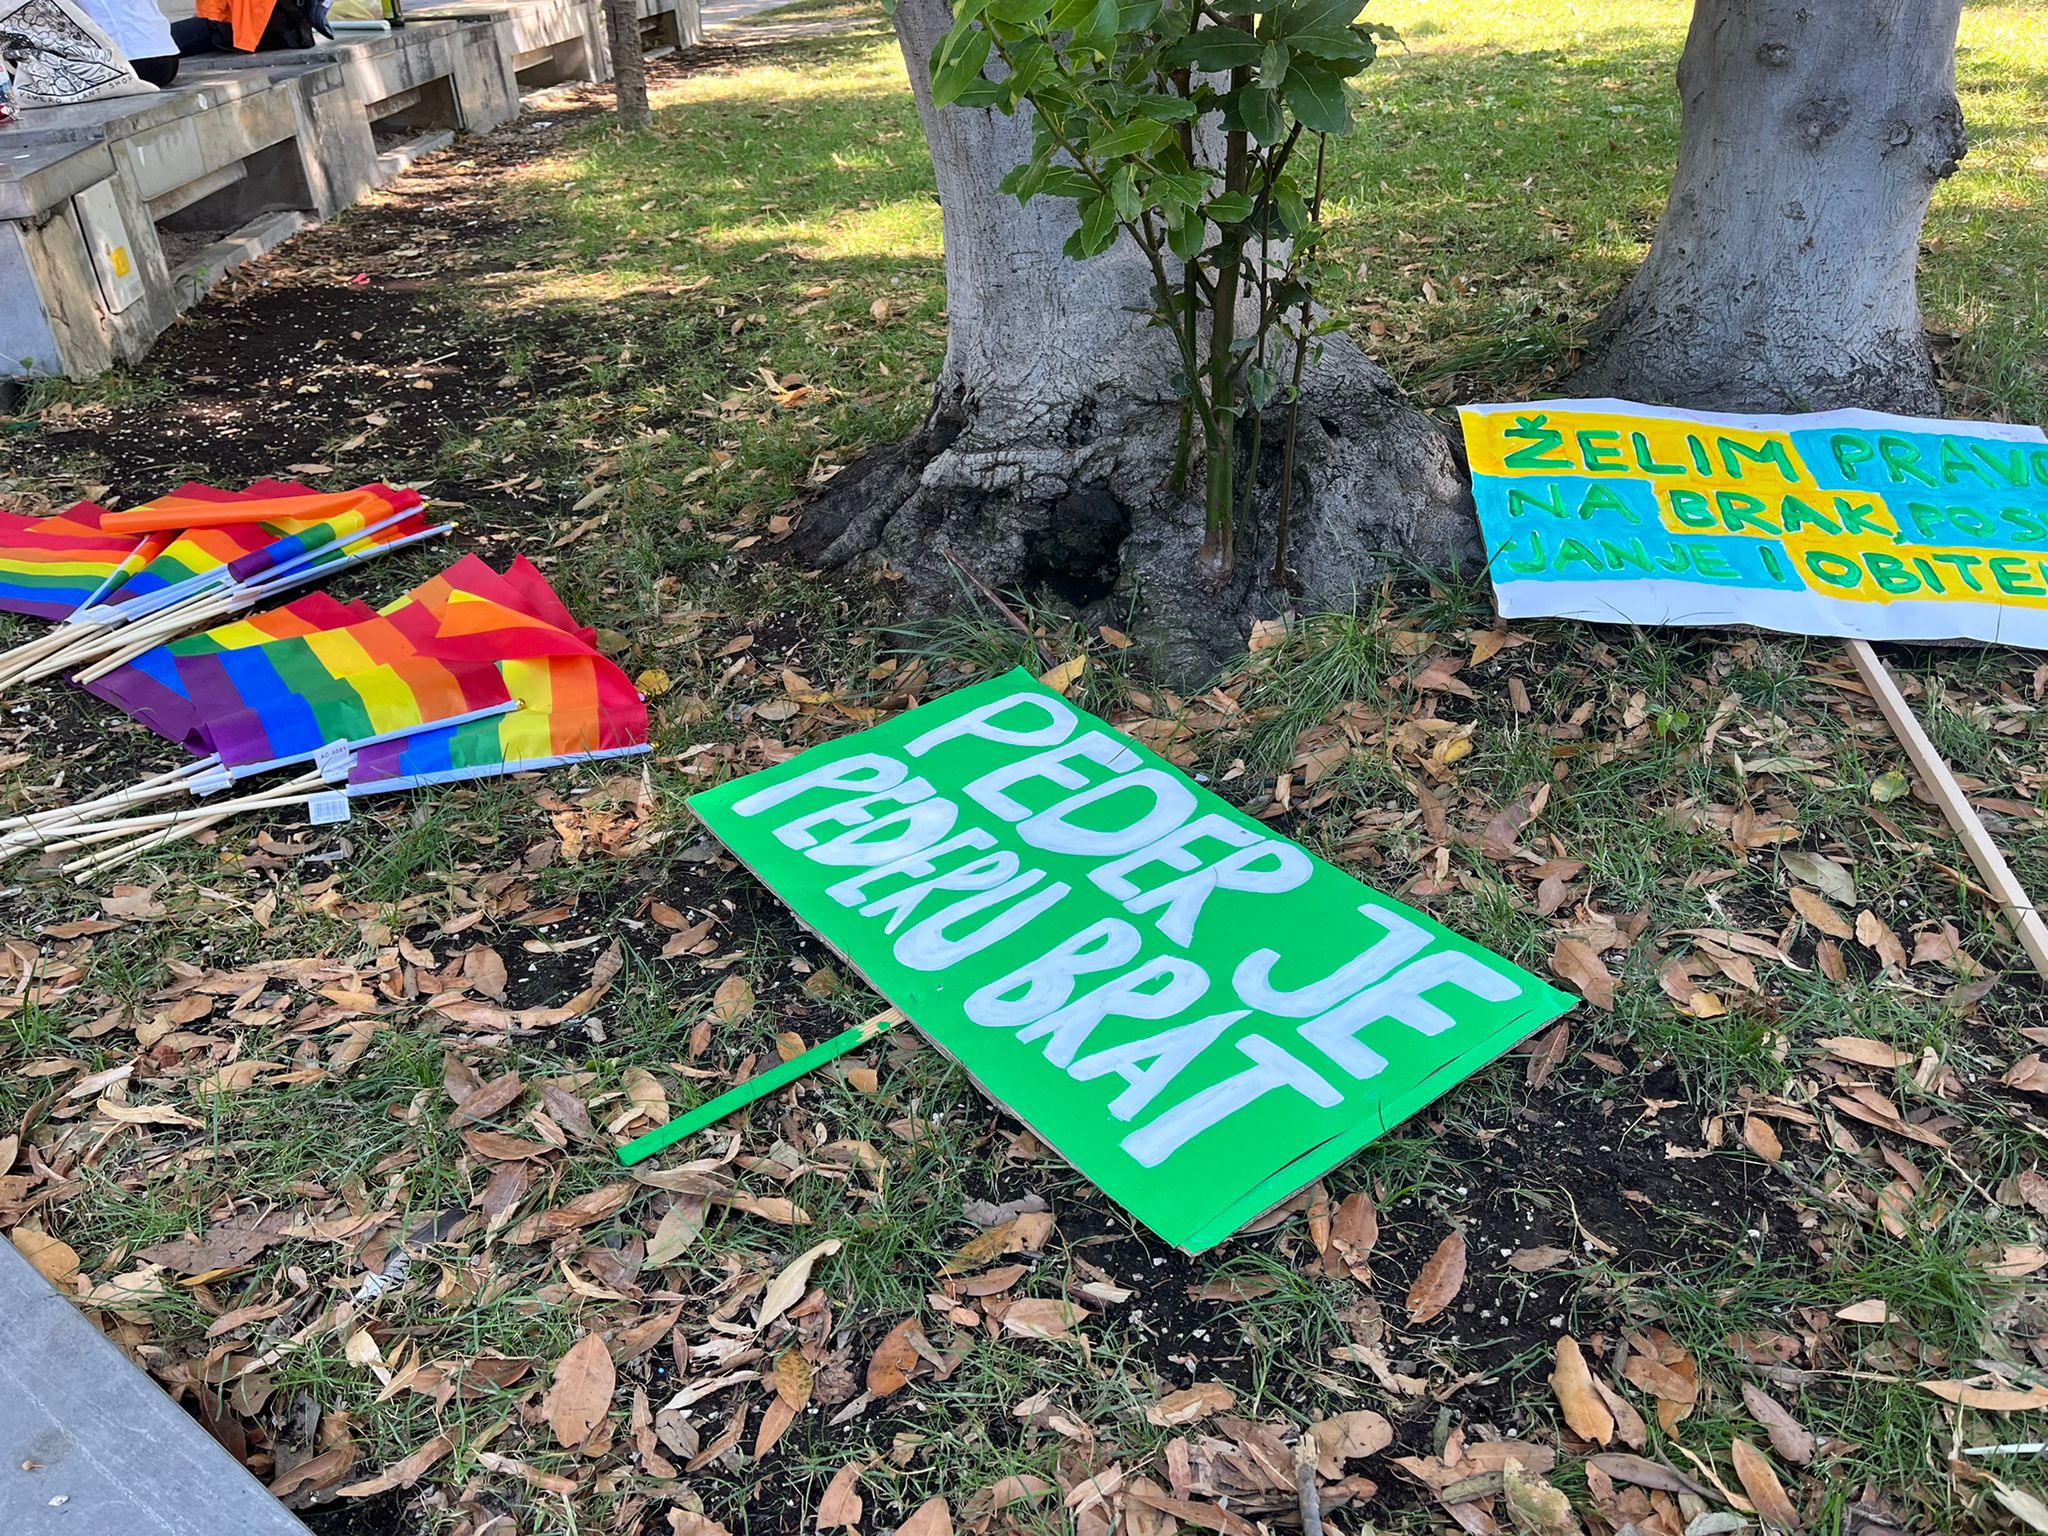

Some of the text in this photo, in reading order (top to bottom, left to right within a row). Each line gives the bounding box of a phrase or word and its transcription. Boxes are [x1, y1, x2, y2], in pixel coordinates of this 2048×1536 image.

[19, 76, 134, 104] VIVERO PLANT SHOP
[1504, 414, 1799, 484] ŽELIM
[1508, 483, 2048, 545] NA BRAK, POS
[1757, 545, 1785, 582] I
[1805, 550, 2048, 597] OBITE
[903, 690, 1523, 1081] PEDER JE
[731, 752, 1344, 1168] PEDERU BRAT
